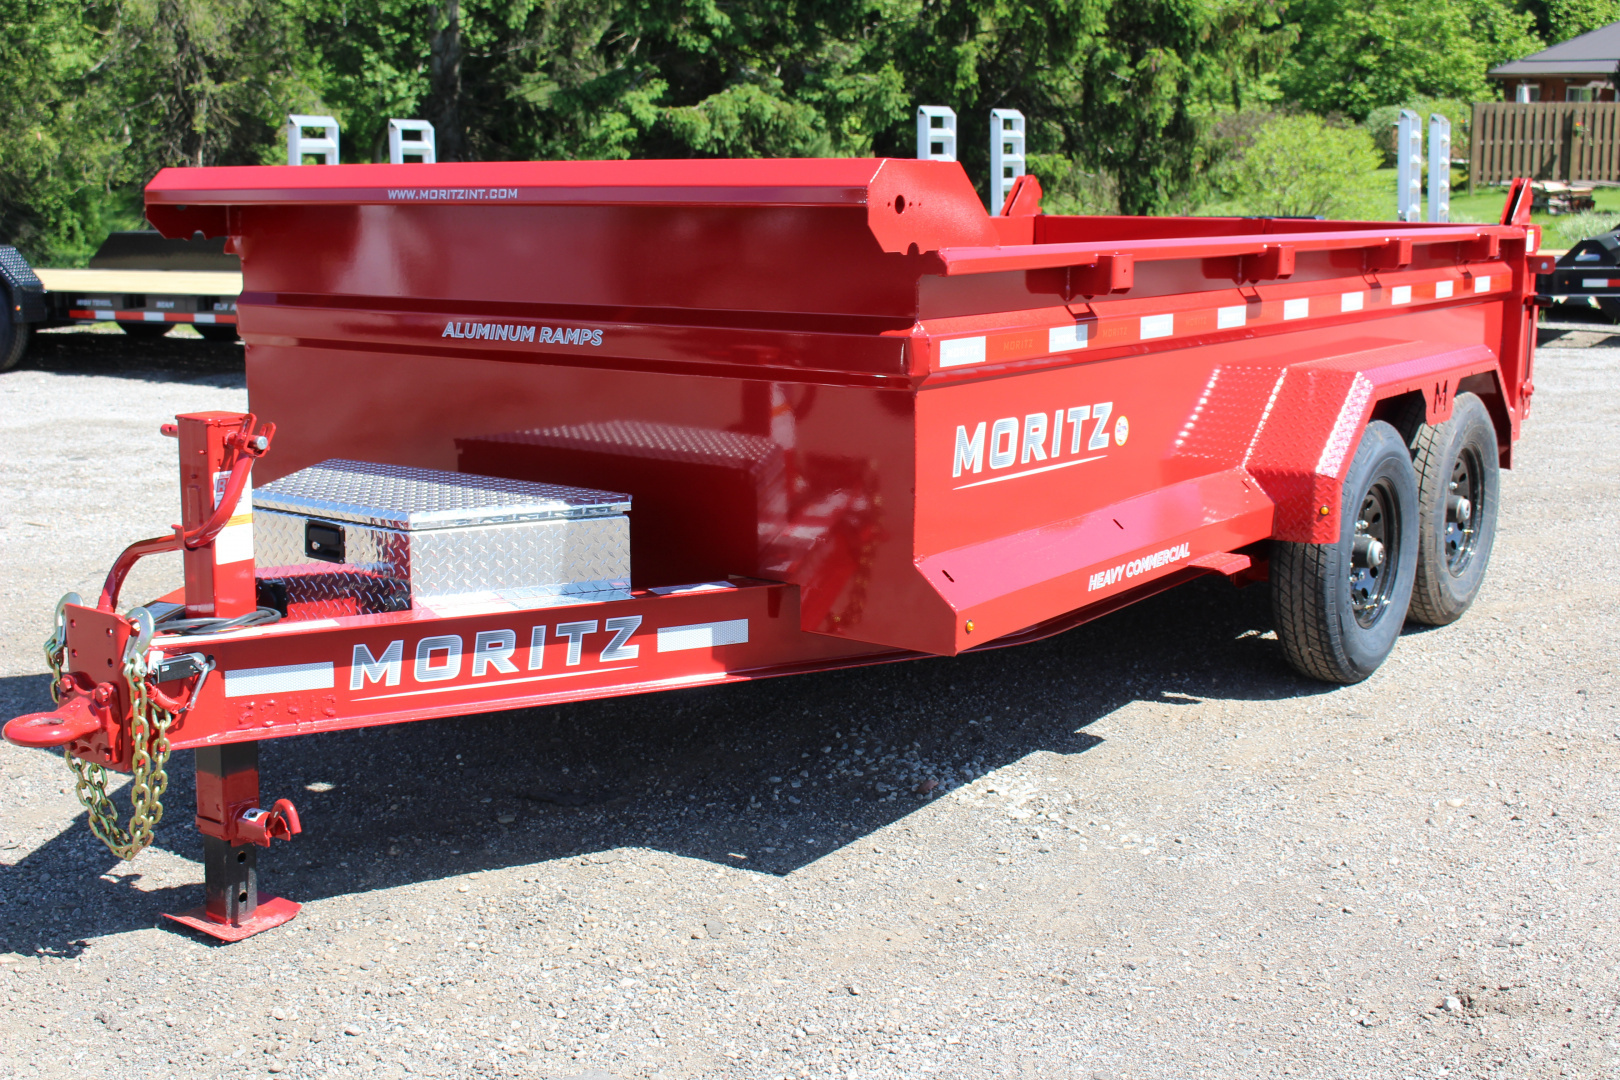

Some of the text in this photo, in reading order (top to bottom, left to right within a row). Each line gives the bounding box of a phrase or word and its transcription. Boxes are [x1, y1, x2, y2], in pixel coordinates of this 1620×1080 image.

[387, 188, 518, 200] WWW.MORITZINT.COM
[441, 321, 604, 347] ALUMINUM RAMPS
[1003, 337, 1034, 352] MORITZ
[952, 401, 1113, 478] MORITZ
[1087, 541, 1191, 592] HEAVY COMMERCIAL
[349, 614, 643, 691] MORITZ
